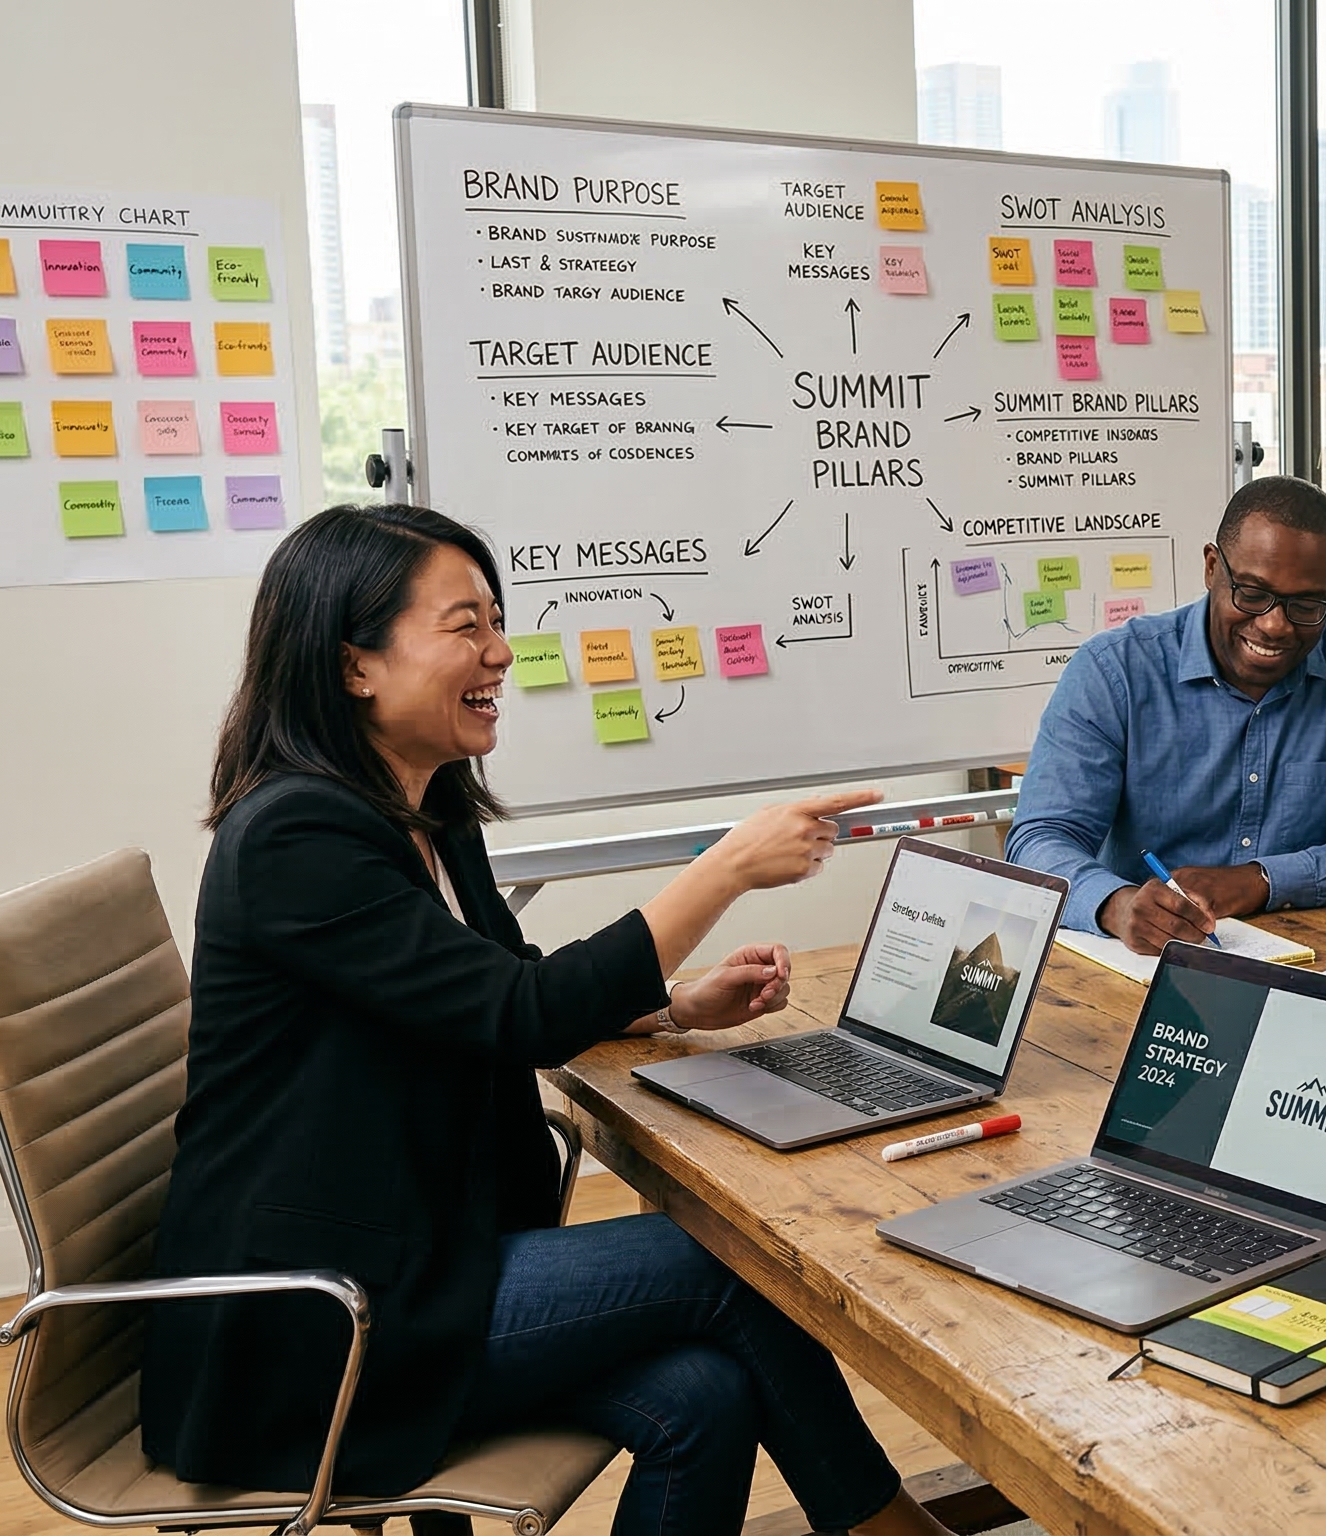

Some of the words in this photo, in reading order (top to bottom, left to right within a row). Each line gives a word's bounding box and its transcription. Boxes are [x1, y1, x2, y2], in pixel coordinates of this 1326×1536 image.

[463, 169, 559, 202] BRAND
[573, 176, 681, 206] PURPOSE
[780, 182, 846, 199] TARGET
[119, 207, 190, 227] CHART
[784, 202, 865, 221] AUDIENCE
[1001, 194, 1062, 221] SWOT
[1071, 199, 1166, 229] ANALYSIS
[488, 225, 547, 242] BRAND
[650, 233, 716, 249] PURPOSE
[803, 242, 835, 260] KEY
[992, 247, 1021, 259] SWOT
[216, 259, 243, 271] Eco-
[491, 255, 531, 269] LAST
[539, 254, 551, 272] &
[788, 264, 870, 281] MESSAGES
[492, 283, 545, 299] BRAND
[553, 286, 602, 300] TARGY
[610, 287, 685, 303] AUDIENCE
[468, 339, 579, 367] TARGET
[591, 340, 712, 367] AUDIENCE
[503, 391, 540, 407] KEY
[550, 391, 646, 407] MESSAGES
[792, 371, 931, 410] SUMMIT
[994, 391, 1064, 413] SUMMIT
[1072, 392, 1128, 413] BRAND
[1135, 393, 1199, 414] PILLARS
[505, 422, 537, 437] KEY
[542, 422, 600, 436] TARGET
[608, 422, 626, 434] OF
[816, 419, 911, 450] BRAND
[1015, 428, 1099, 443] COMPETITIVE
[609, 446, 695, 460] COSDENCES
[1016, 451, 1063, 466] BRAND
[1068, 451, 1119, 464] PILLARS
[812, 458, 924, 489] PILLARS
[1018, 473, 1074, 489] SUMMIT
[1081, 472, 1137, 486] PILLARS
[963, 516, 1066, 537] COMPETITIVE
[1075, 512, 1161, 532] LANDSCAPE
[510, 544, 561, 572] KEY
[576, 538, 707, 568] MESSAGES
[565, 588, 643, 604] INNOVATION
[791, 595, 833, 611] SWOT
[792, 611, 844, 626] ANALYSIS
[961, 964, 1002, 992] SUMMIT
[1152, 1022, 1209, 1050] BRAND
[1145, 1043, 1228, 1078] STRATEGY
[1137, 1064, 1176, 1088] 2024
